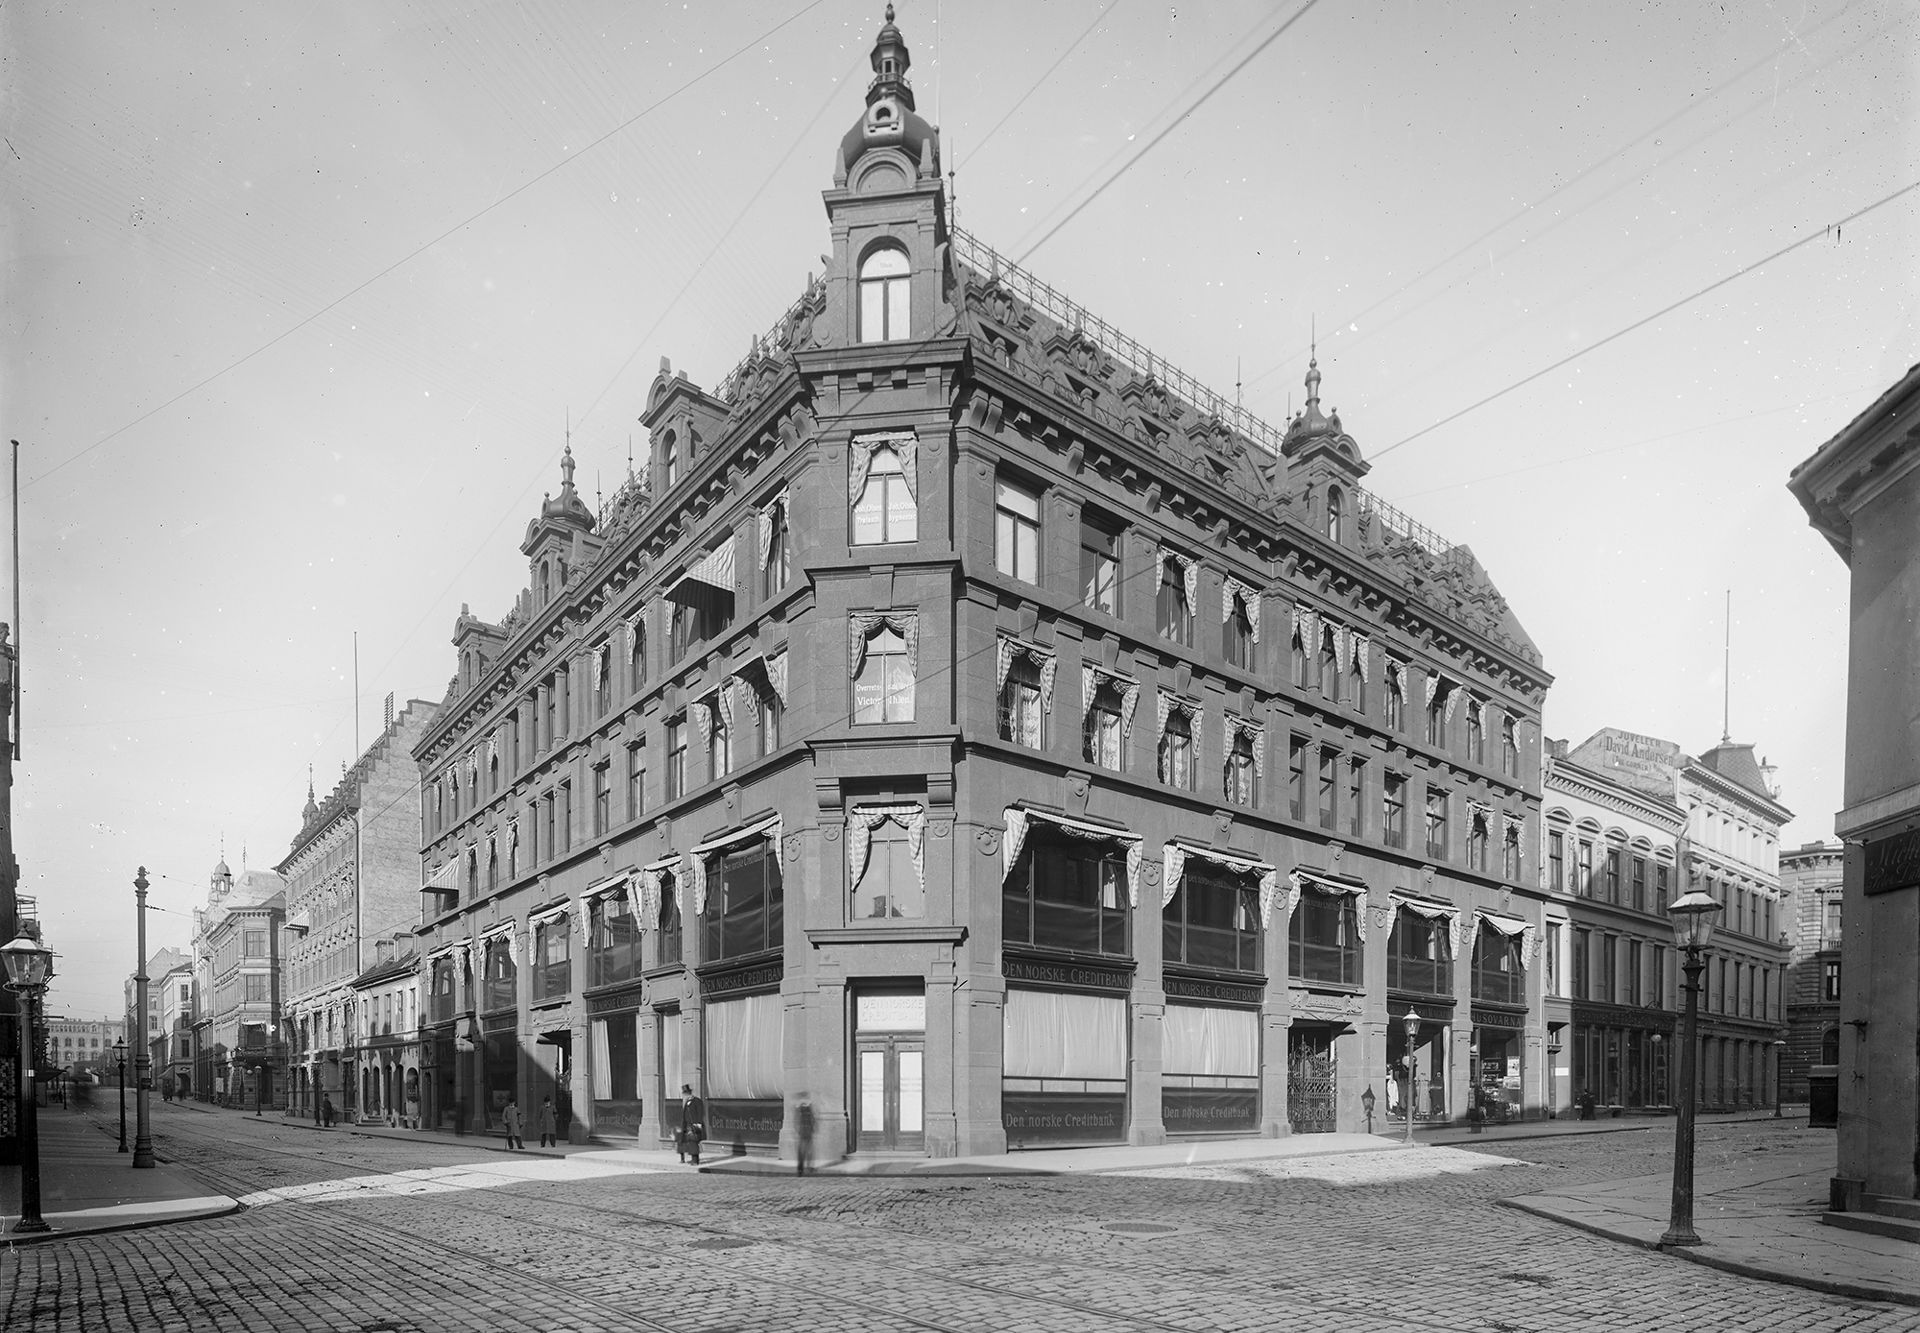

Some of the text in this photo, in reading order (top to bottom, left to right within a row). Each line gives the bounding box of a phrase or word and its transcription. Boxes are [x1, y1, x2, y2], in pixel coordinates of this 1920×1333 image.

[1606, 735, 1674, 766] David Andersen
[716, 975, 741, 990] NORSKE
[742, 968, 783, 985] CREDITBAN
[1003, 960, 1129, 988] DEN NORSKE CREDITBANK
[1180, 983, 1211, 997] NORSKE
[1214, 985, 1261, 1001] CREDITBANK
[1006, 1112, 1115, 1127] Den norske Creditbank
[1164, 1105, 1250, 1119] Den norske Creditbank
[712, 1115, 782, 1131] Den norske Creditban
